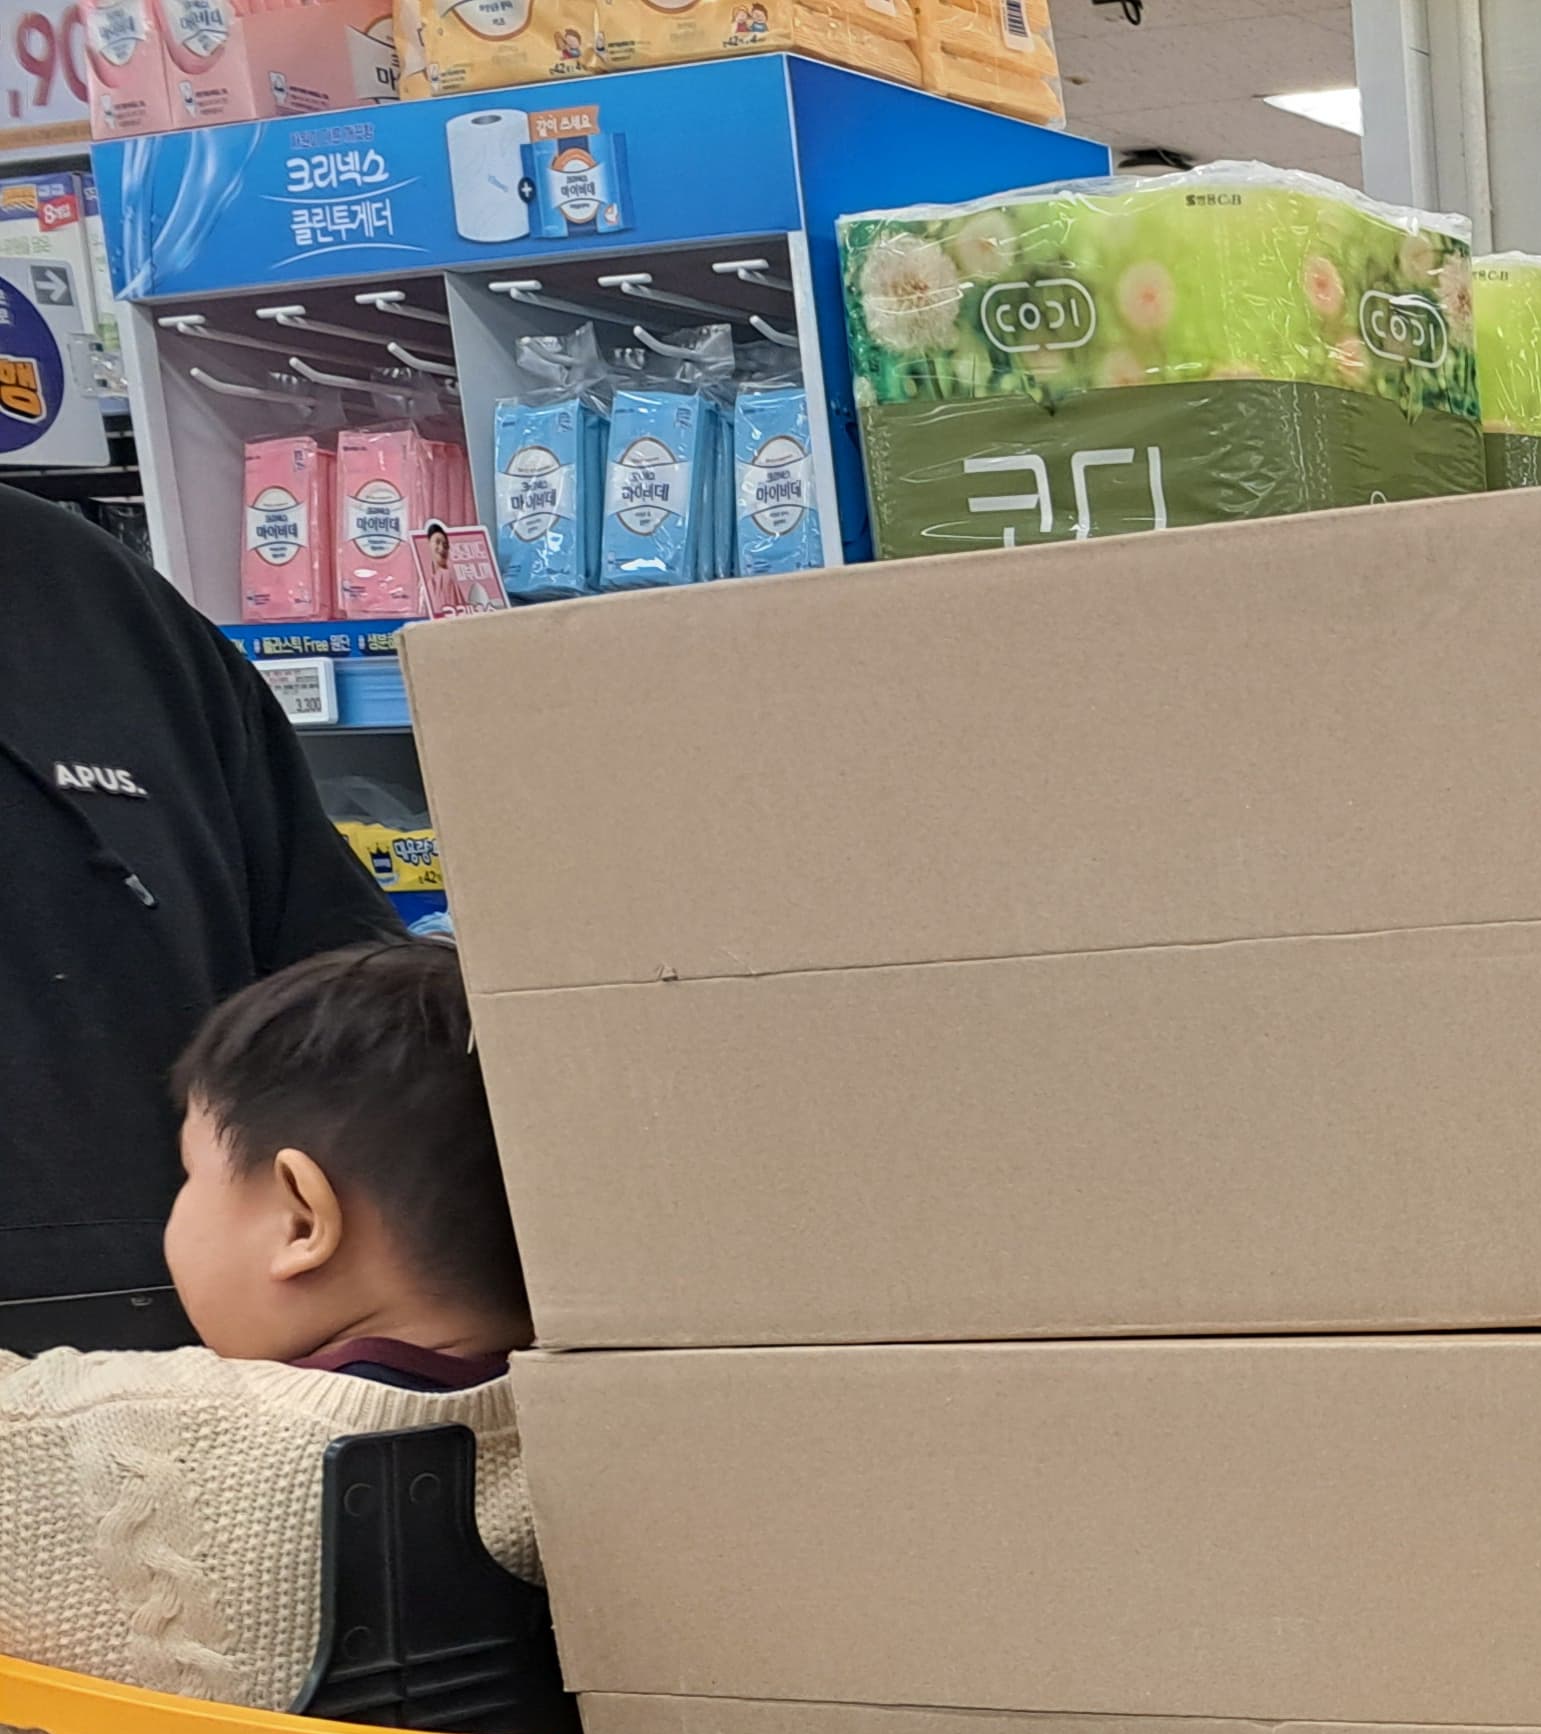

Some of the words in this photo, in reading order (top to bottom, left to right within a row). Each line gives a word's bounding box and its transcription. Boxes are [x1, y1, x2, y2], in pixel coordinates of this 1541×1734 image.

[286, 148, 390, 192] 크리넥스
[290, 198, 395, 246] 클린투게더
[755, 480, 802, 502] 마이비데
[256, 523, 298, 539] 마이비데
[356, 516, 401, 532] 마이비데
[304, 637, 328, 651] Free
